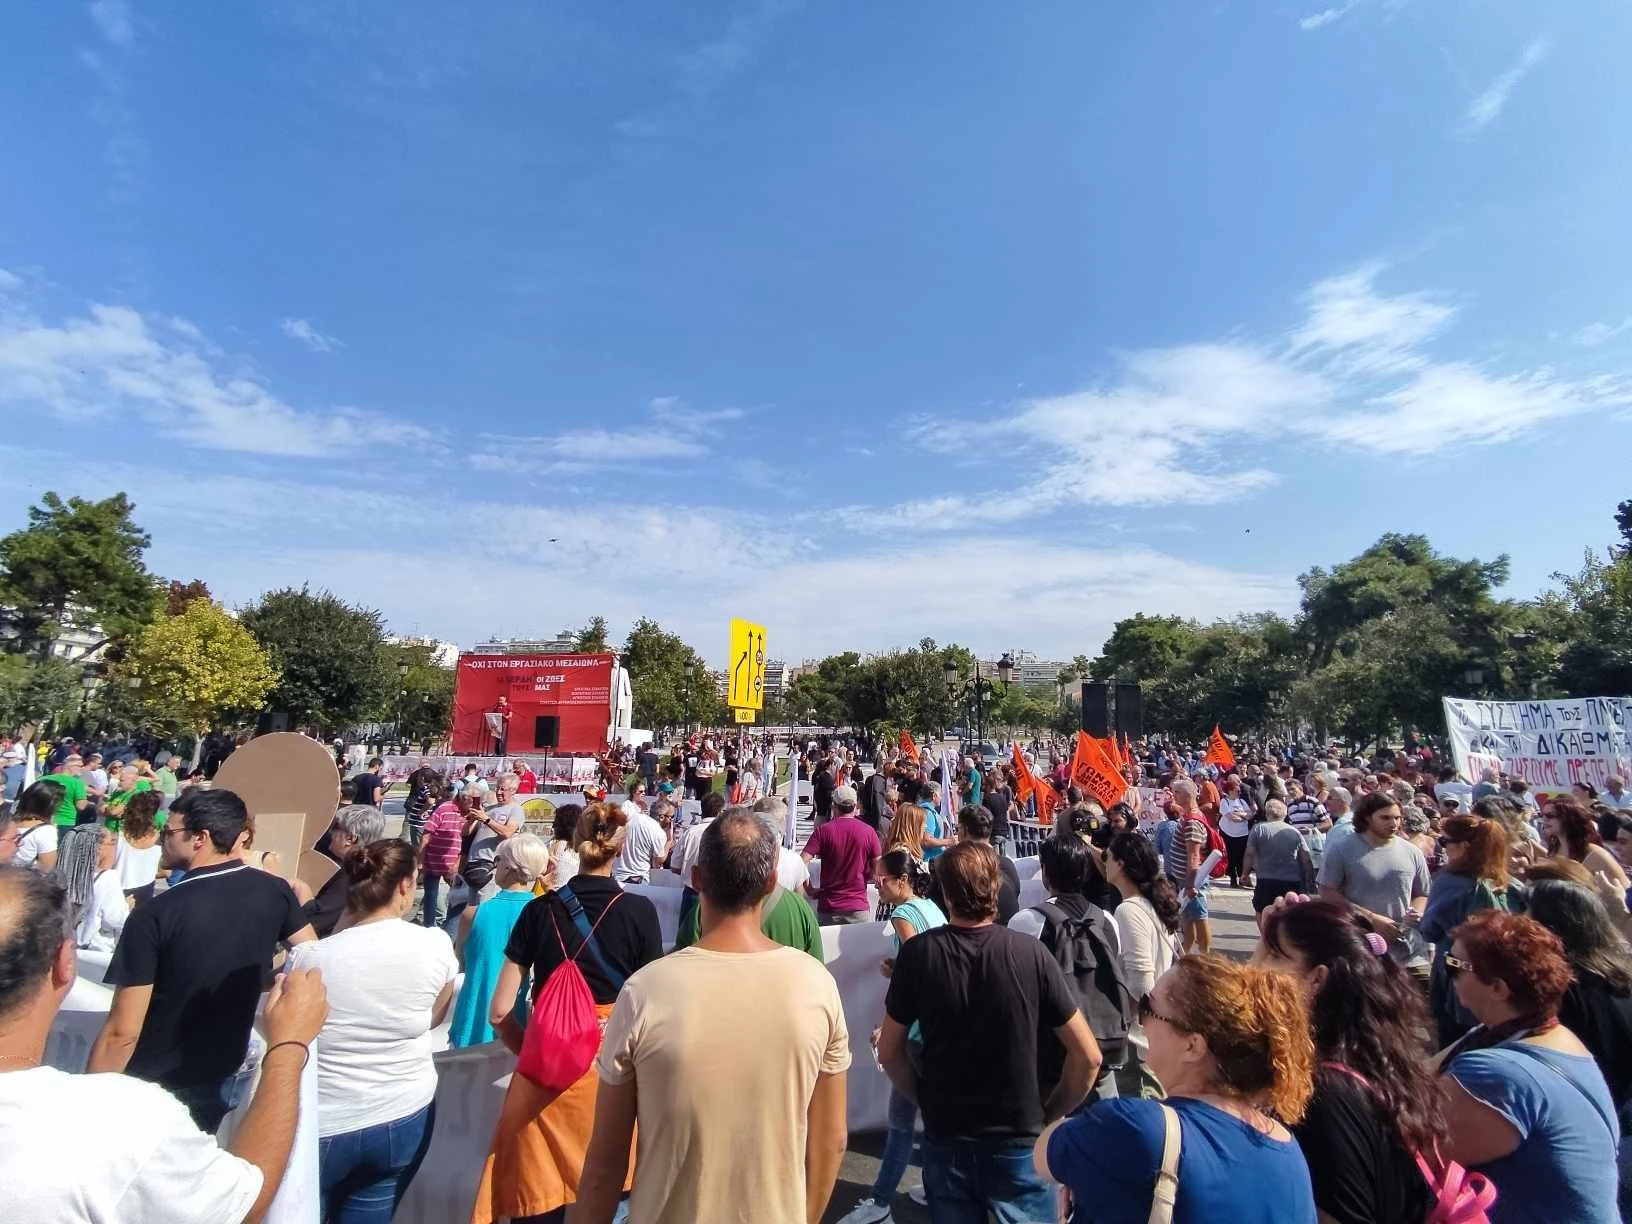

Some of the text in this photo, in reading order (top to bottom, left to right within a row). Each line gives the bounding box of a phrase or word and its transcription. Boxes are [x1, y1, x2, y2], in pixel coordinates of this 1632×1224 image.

[472, 659, 599, 669] ΟΧΙ ΣΤΟΝ ΕΡΓΑΣΙΑΚΟ ΜΕΣΑΙΩΝΑ
[545, 674, 566, 683] ΖΩΕΣ
[535, 683, 551, 691] ΜΑΣ
[1475, 702, 1555, 730] ΣΥΣΤΗΜΑ
[1567, 758, 1610, 786] ΠΡΕΠΕΙ
